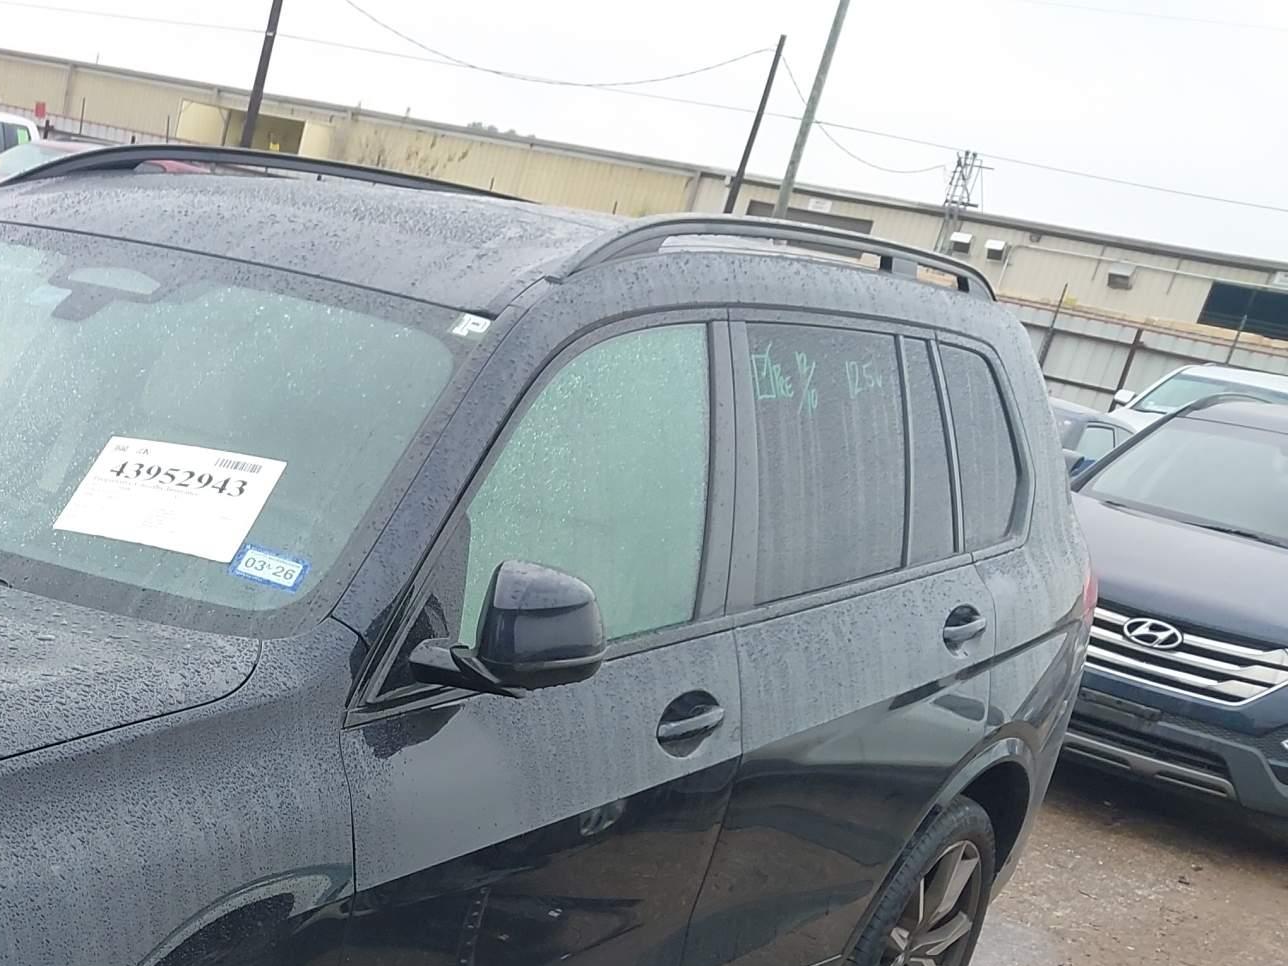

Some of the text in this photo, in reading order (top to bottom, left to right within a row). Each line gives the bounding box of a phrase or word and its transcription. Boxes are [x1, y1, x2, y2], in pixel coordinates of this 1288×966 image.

[110, 461, 248, 497] 43952943
[244, 556, 267, 572] 03
[272, 565, 297, 580] 26
